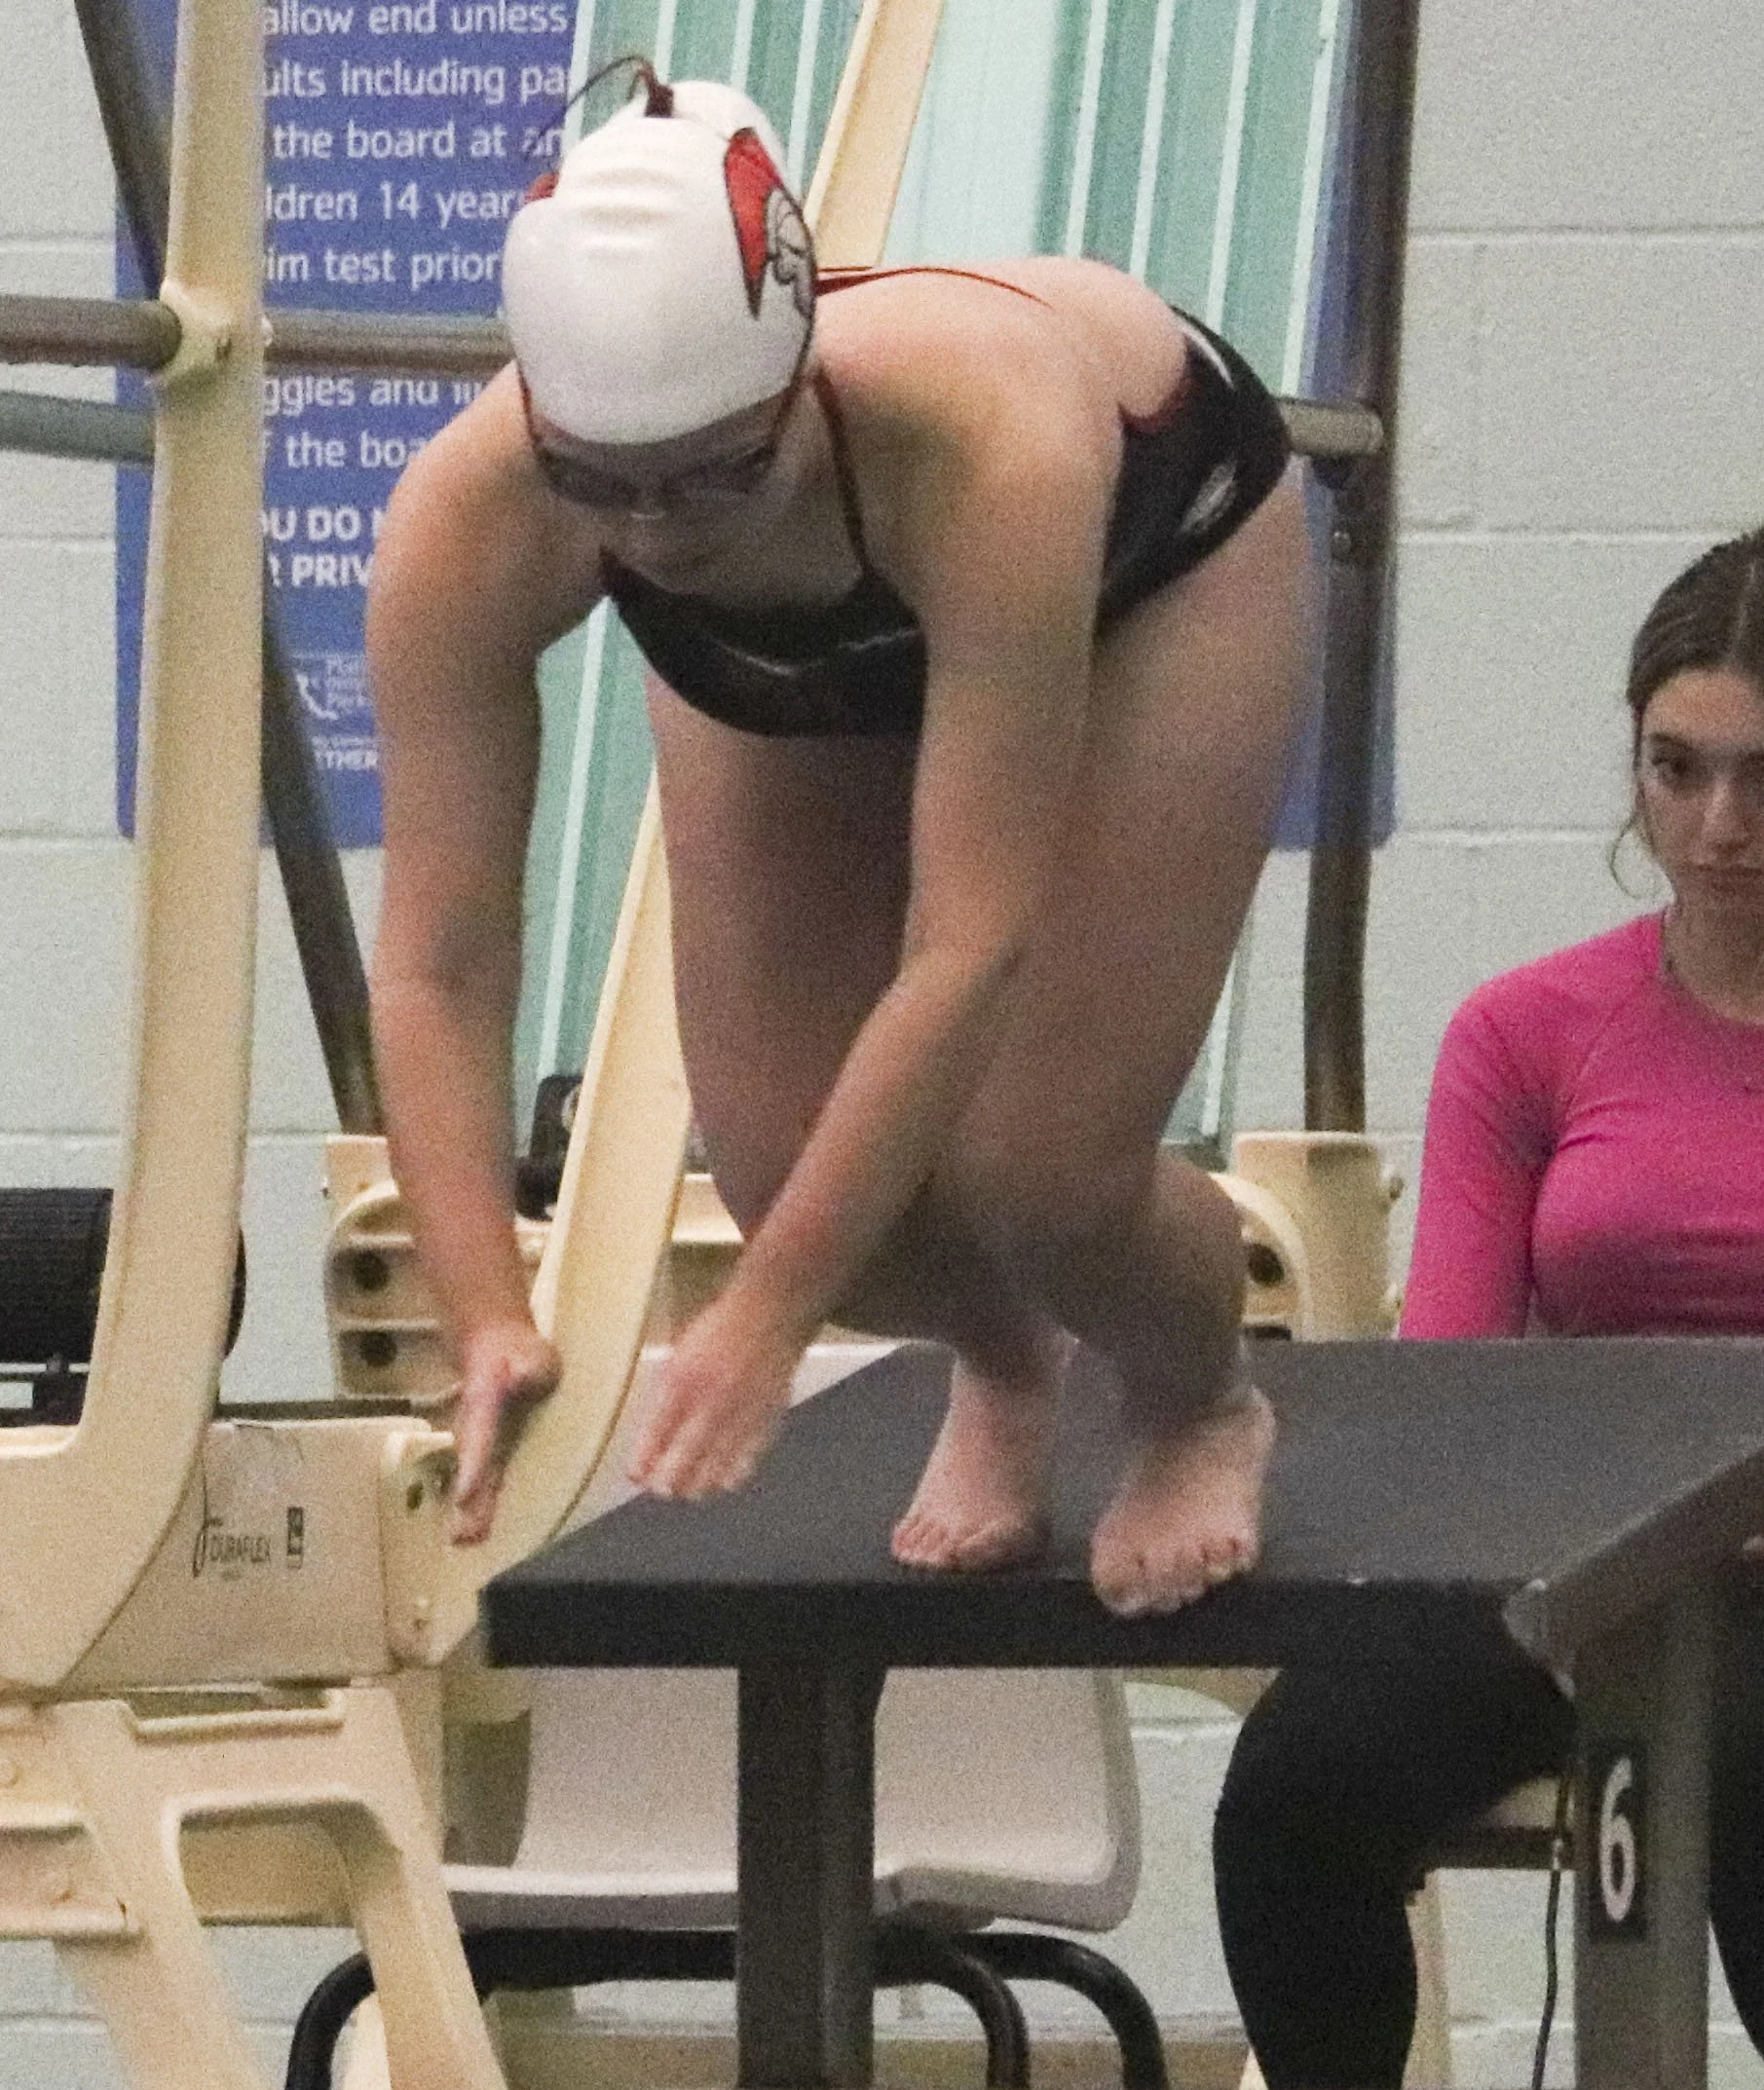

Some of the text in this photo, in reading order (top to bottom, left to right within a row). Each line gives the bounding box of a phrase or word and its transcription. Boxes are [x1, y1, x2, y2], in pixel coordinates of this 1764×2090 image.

[369, 0, 437, 34] end
[451, 0, 569, 34] unless
[342, 57, 507, 105] including
[273, 122, 334, 159] the
[347, 118, 456, 159] board
[470, 127, 507, 159] at
[380, 181, 421, 221] 14
[435, 189, 525, 231] year
[324, 249, 395, 283] test
[410, 246, 501, 292] prior
[285, 430, 347, 469] the
[306, 506, 361, 541] DO
[1599, 1756, 1636, 1922] 6
